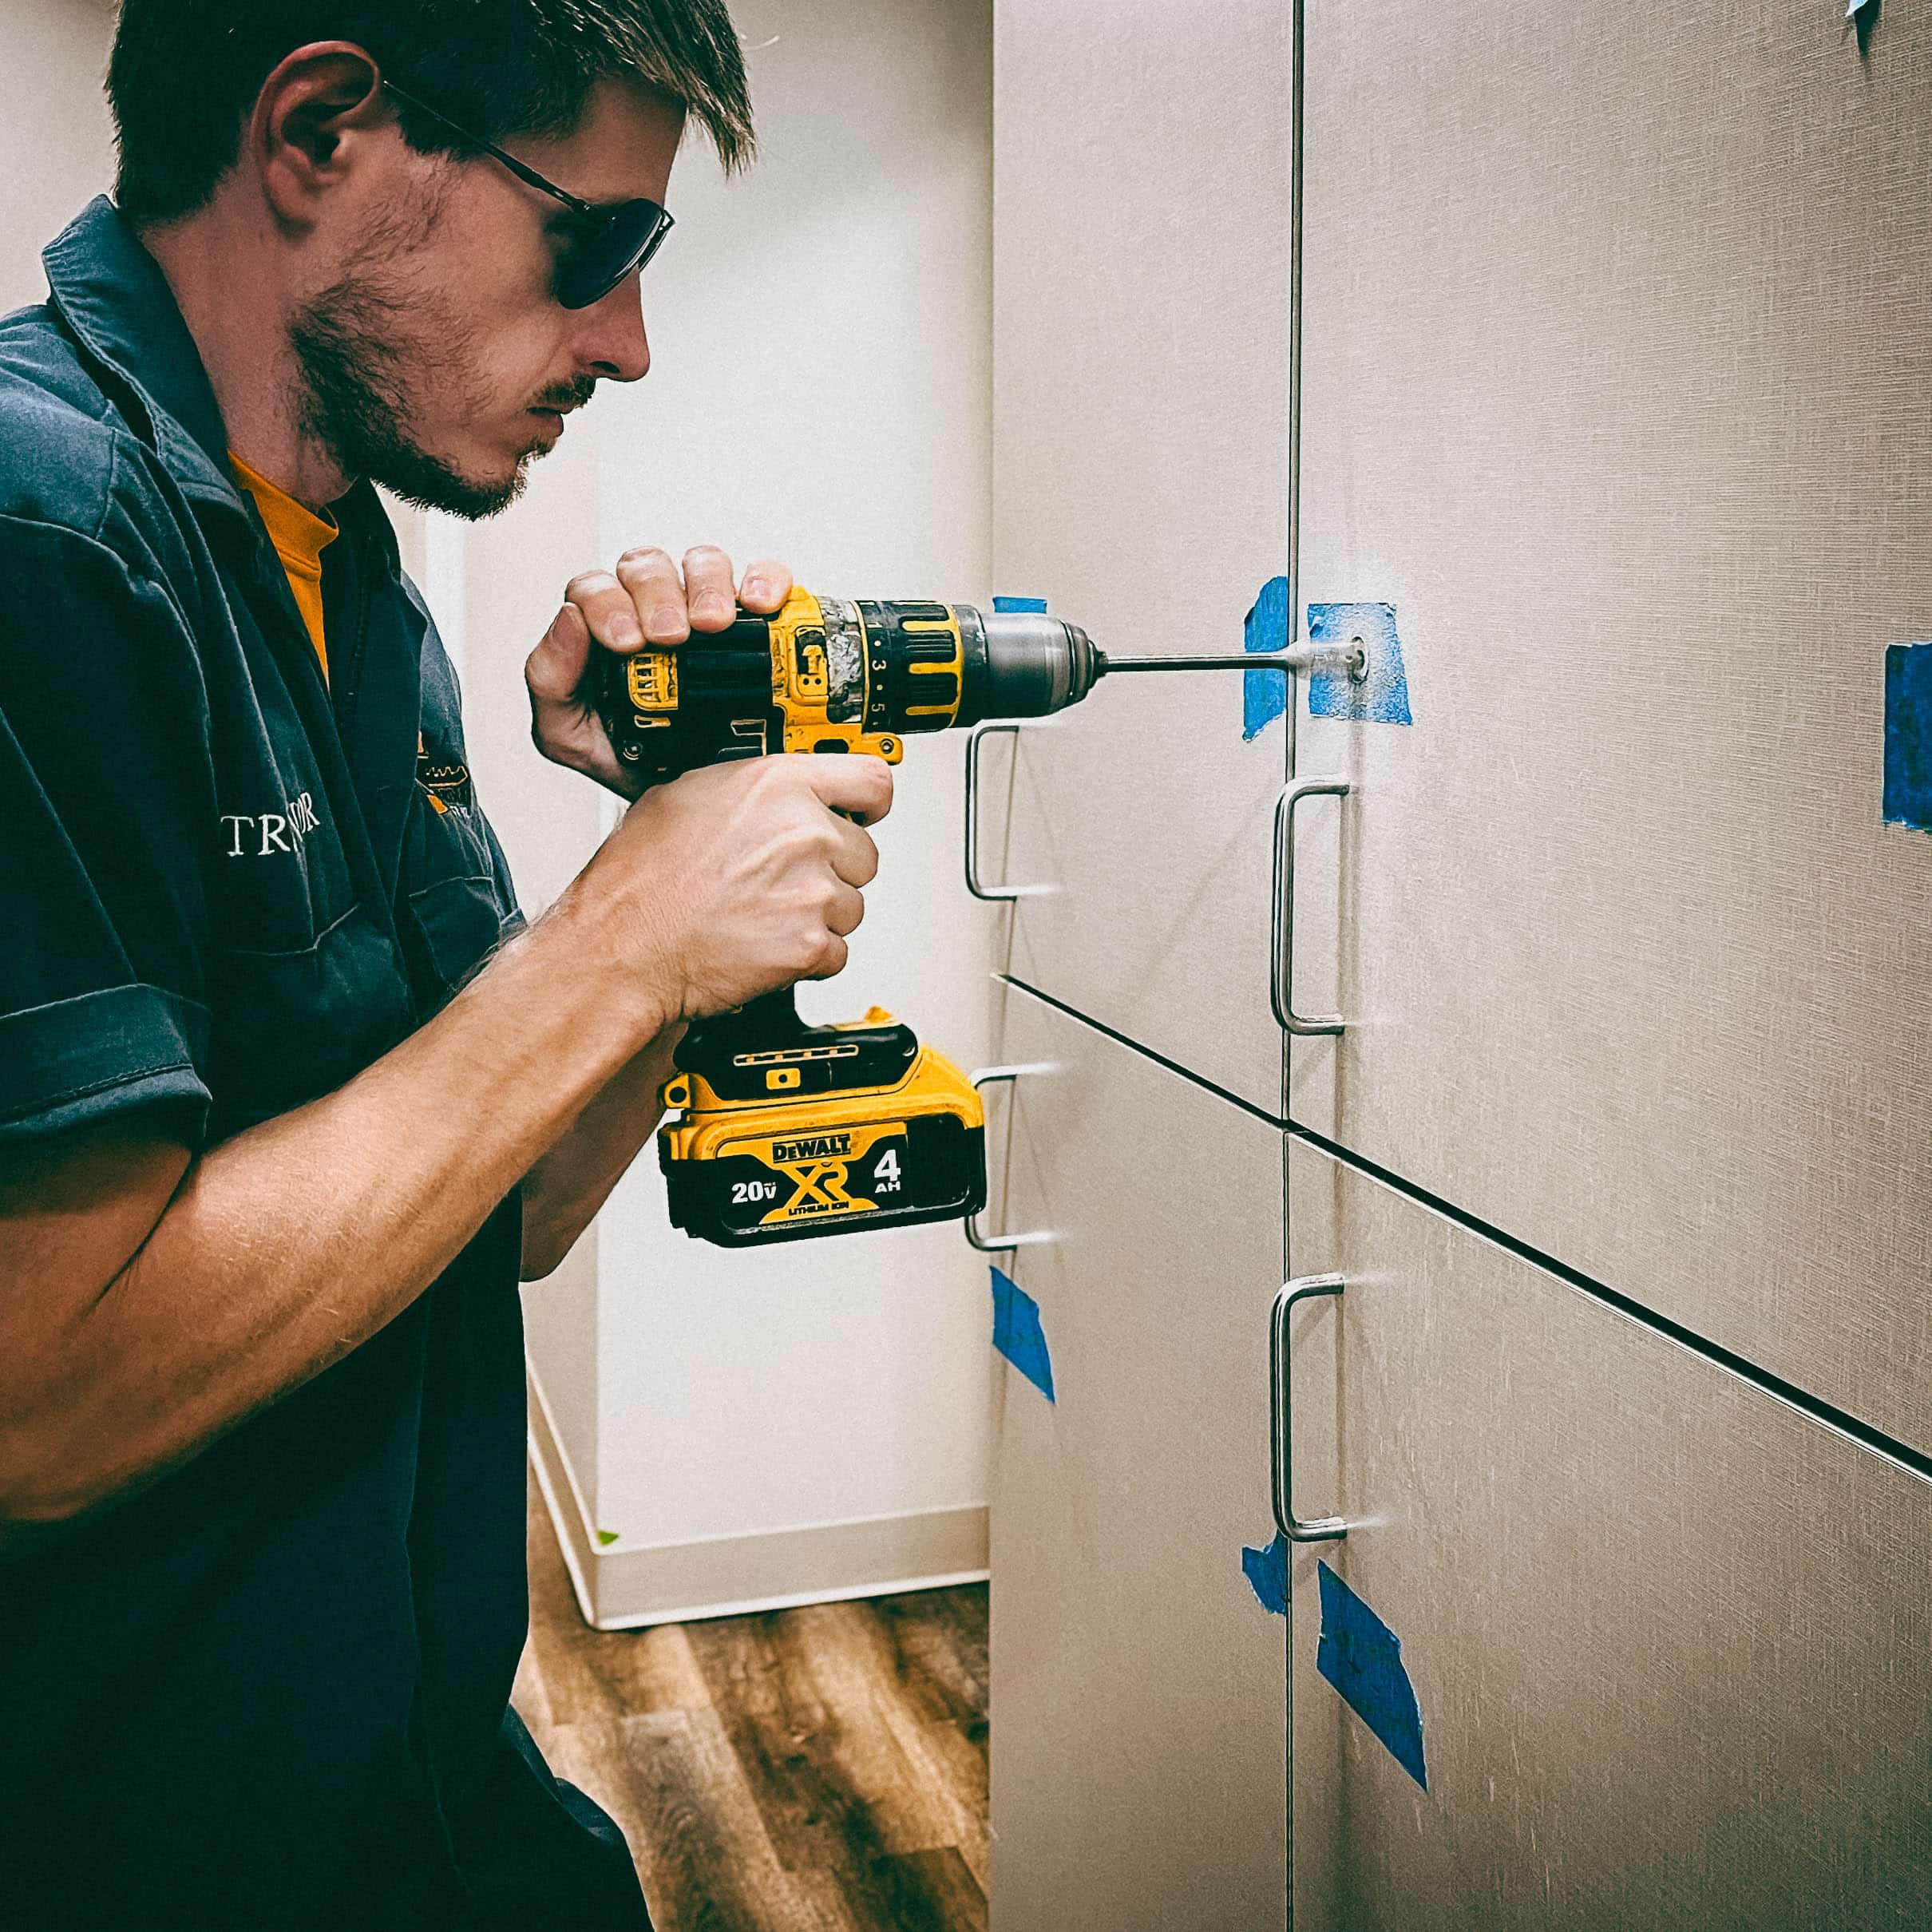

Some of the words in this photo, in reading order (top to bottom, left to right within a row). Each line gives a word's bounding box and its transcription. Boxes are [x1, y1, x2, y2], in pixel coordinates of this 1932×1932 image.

[872, 659, 886, 671] 3
[871, 703, 885, 712] 5
[220, 791, 320, 857] TRVOR
[873, 1149, 901, 1182] 4
[782, 1162, 853, 1209] XR
[789, 1203, 829, 1216] LITHIUM
[832, 1201, 849, 1210] ION
